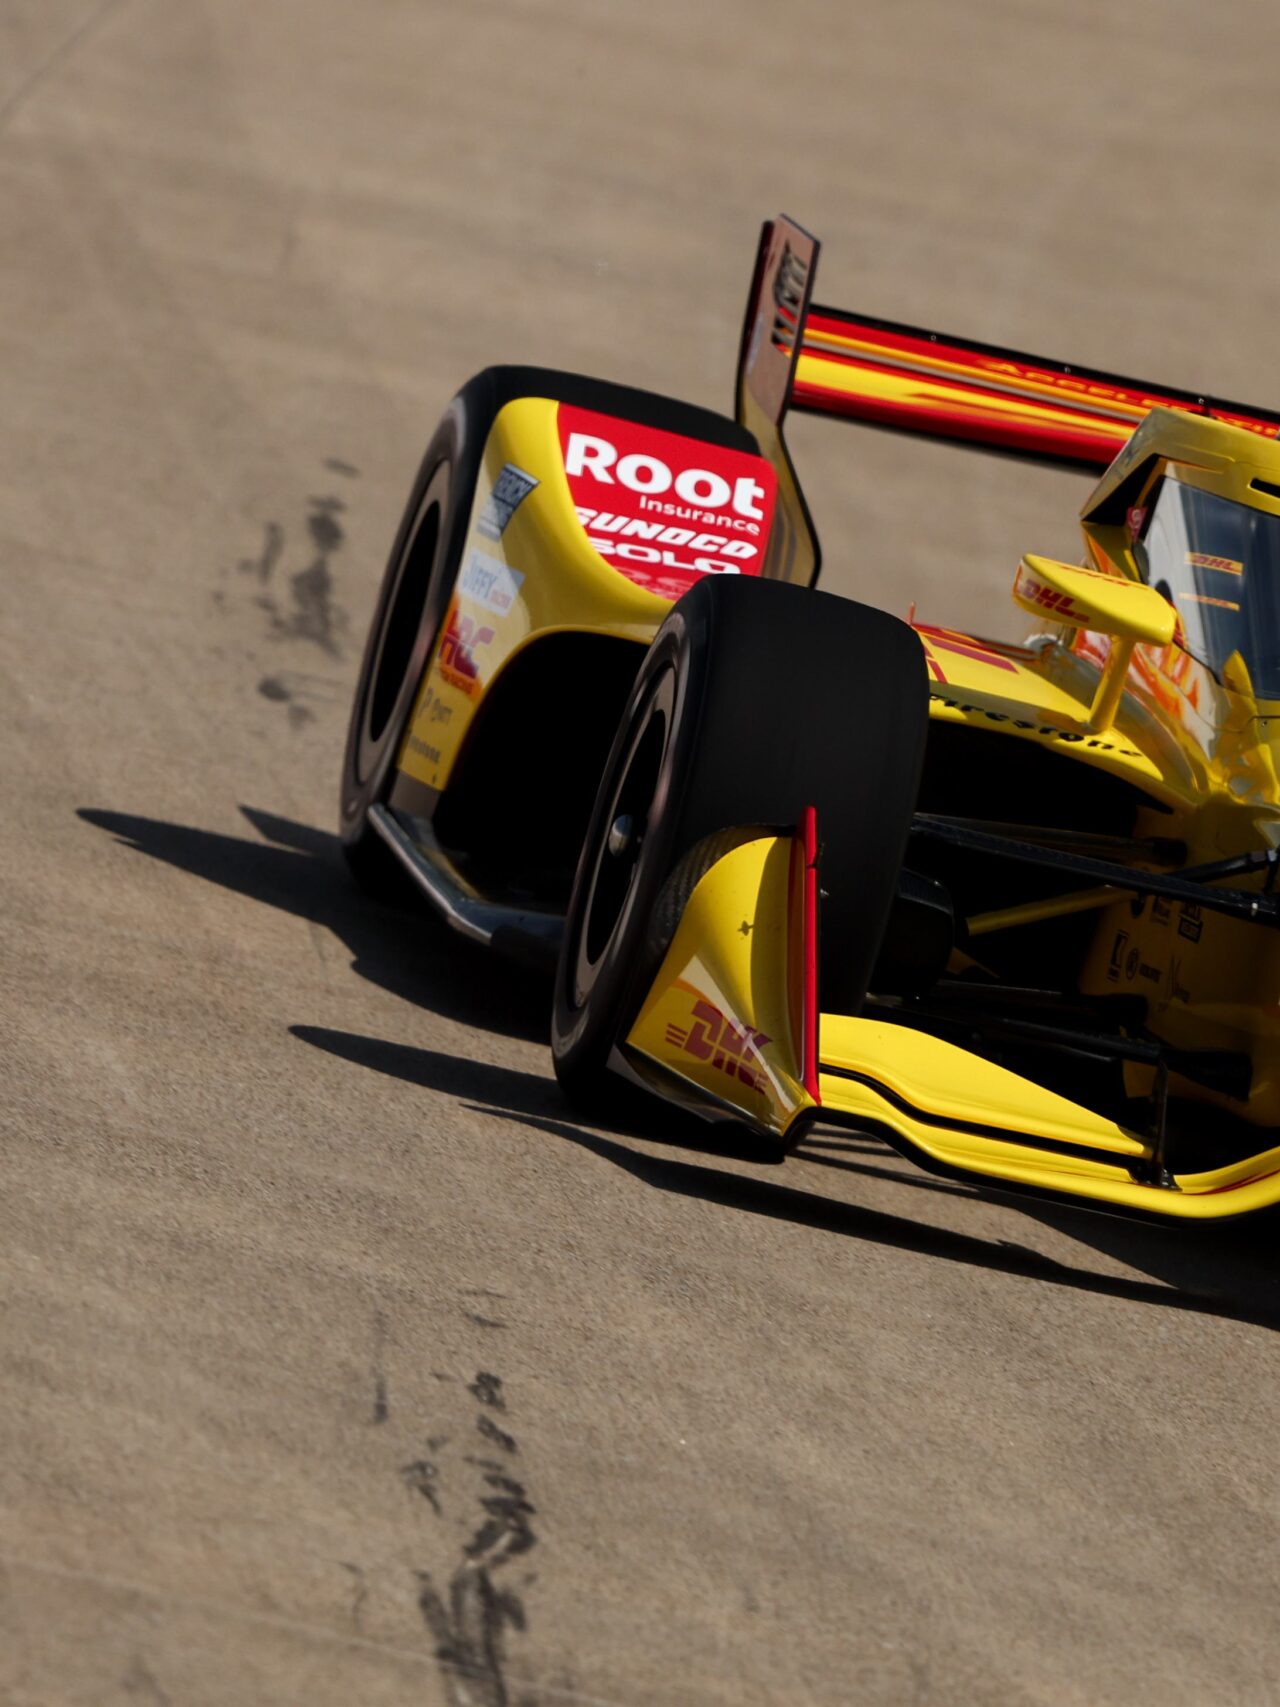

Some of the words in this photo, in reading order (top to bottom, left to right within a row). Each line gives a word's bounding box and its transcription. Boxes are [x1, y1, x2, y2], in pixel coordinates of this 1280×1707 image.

[566, 432, 765, 521] Root
[574, 505, 758, 560] SUNOCO
[639, 495, 761, 536] Insurance
[587, 537, 741, 576] SOLO
[1023, 579, 1080, 619] DHL
